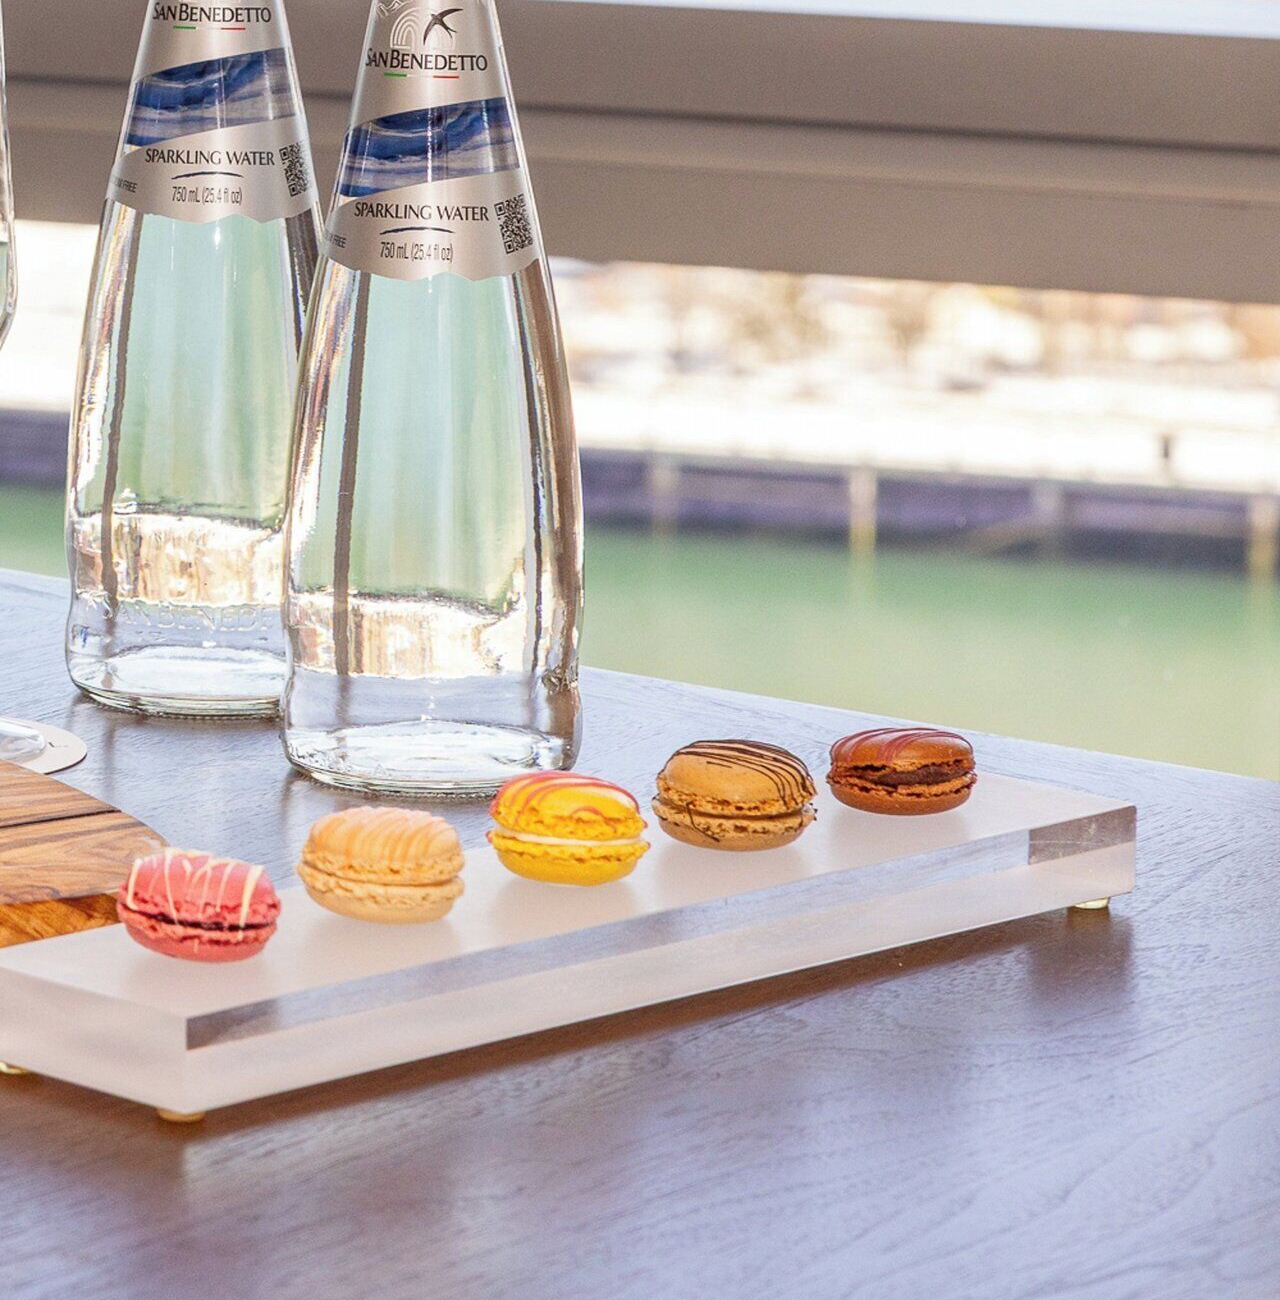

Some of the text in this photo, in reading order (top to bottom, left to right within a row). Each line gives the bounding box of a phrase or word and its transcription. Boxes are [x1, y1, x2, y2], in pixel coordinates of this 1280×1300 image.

[144, 148, 275, 166] SPARKLING WATER
[172, 186, 187, 202] 750
[354, 201, 490, 221] SPARKLING WATER
[380, 241, 395, 258] 750
